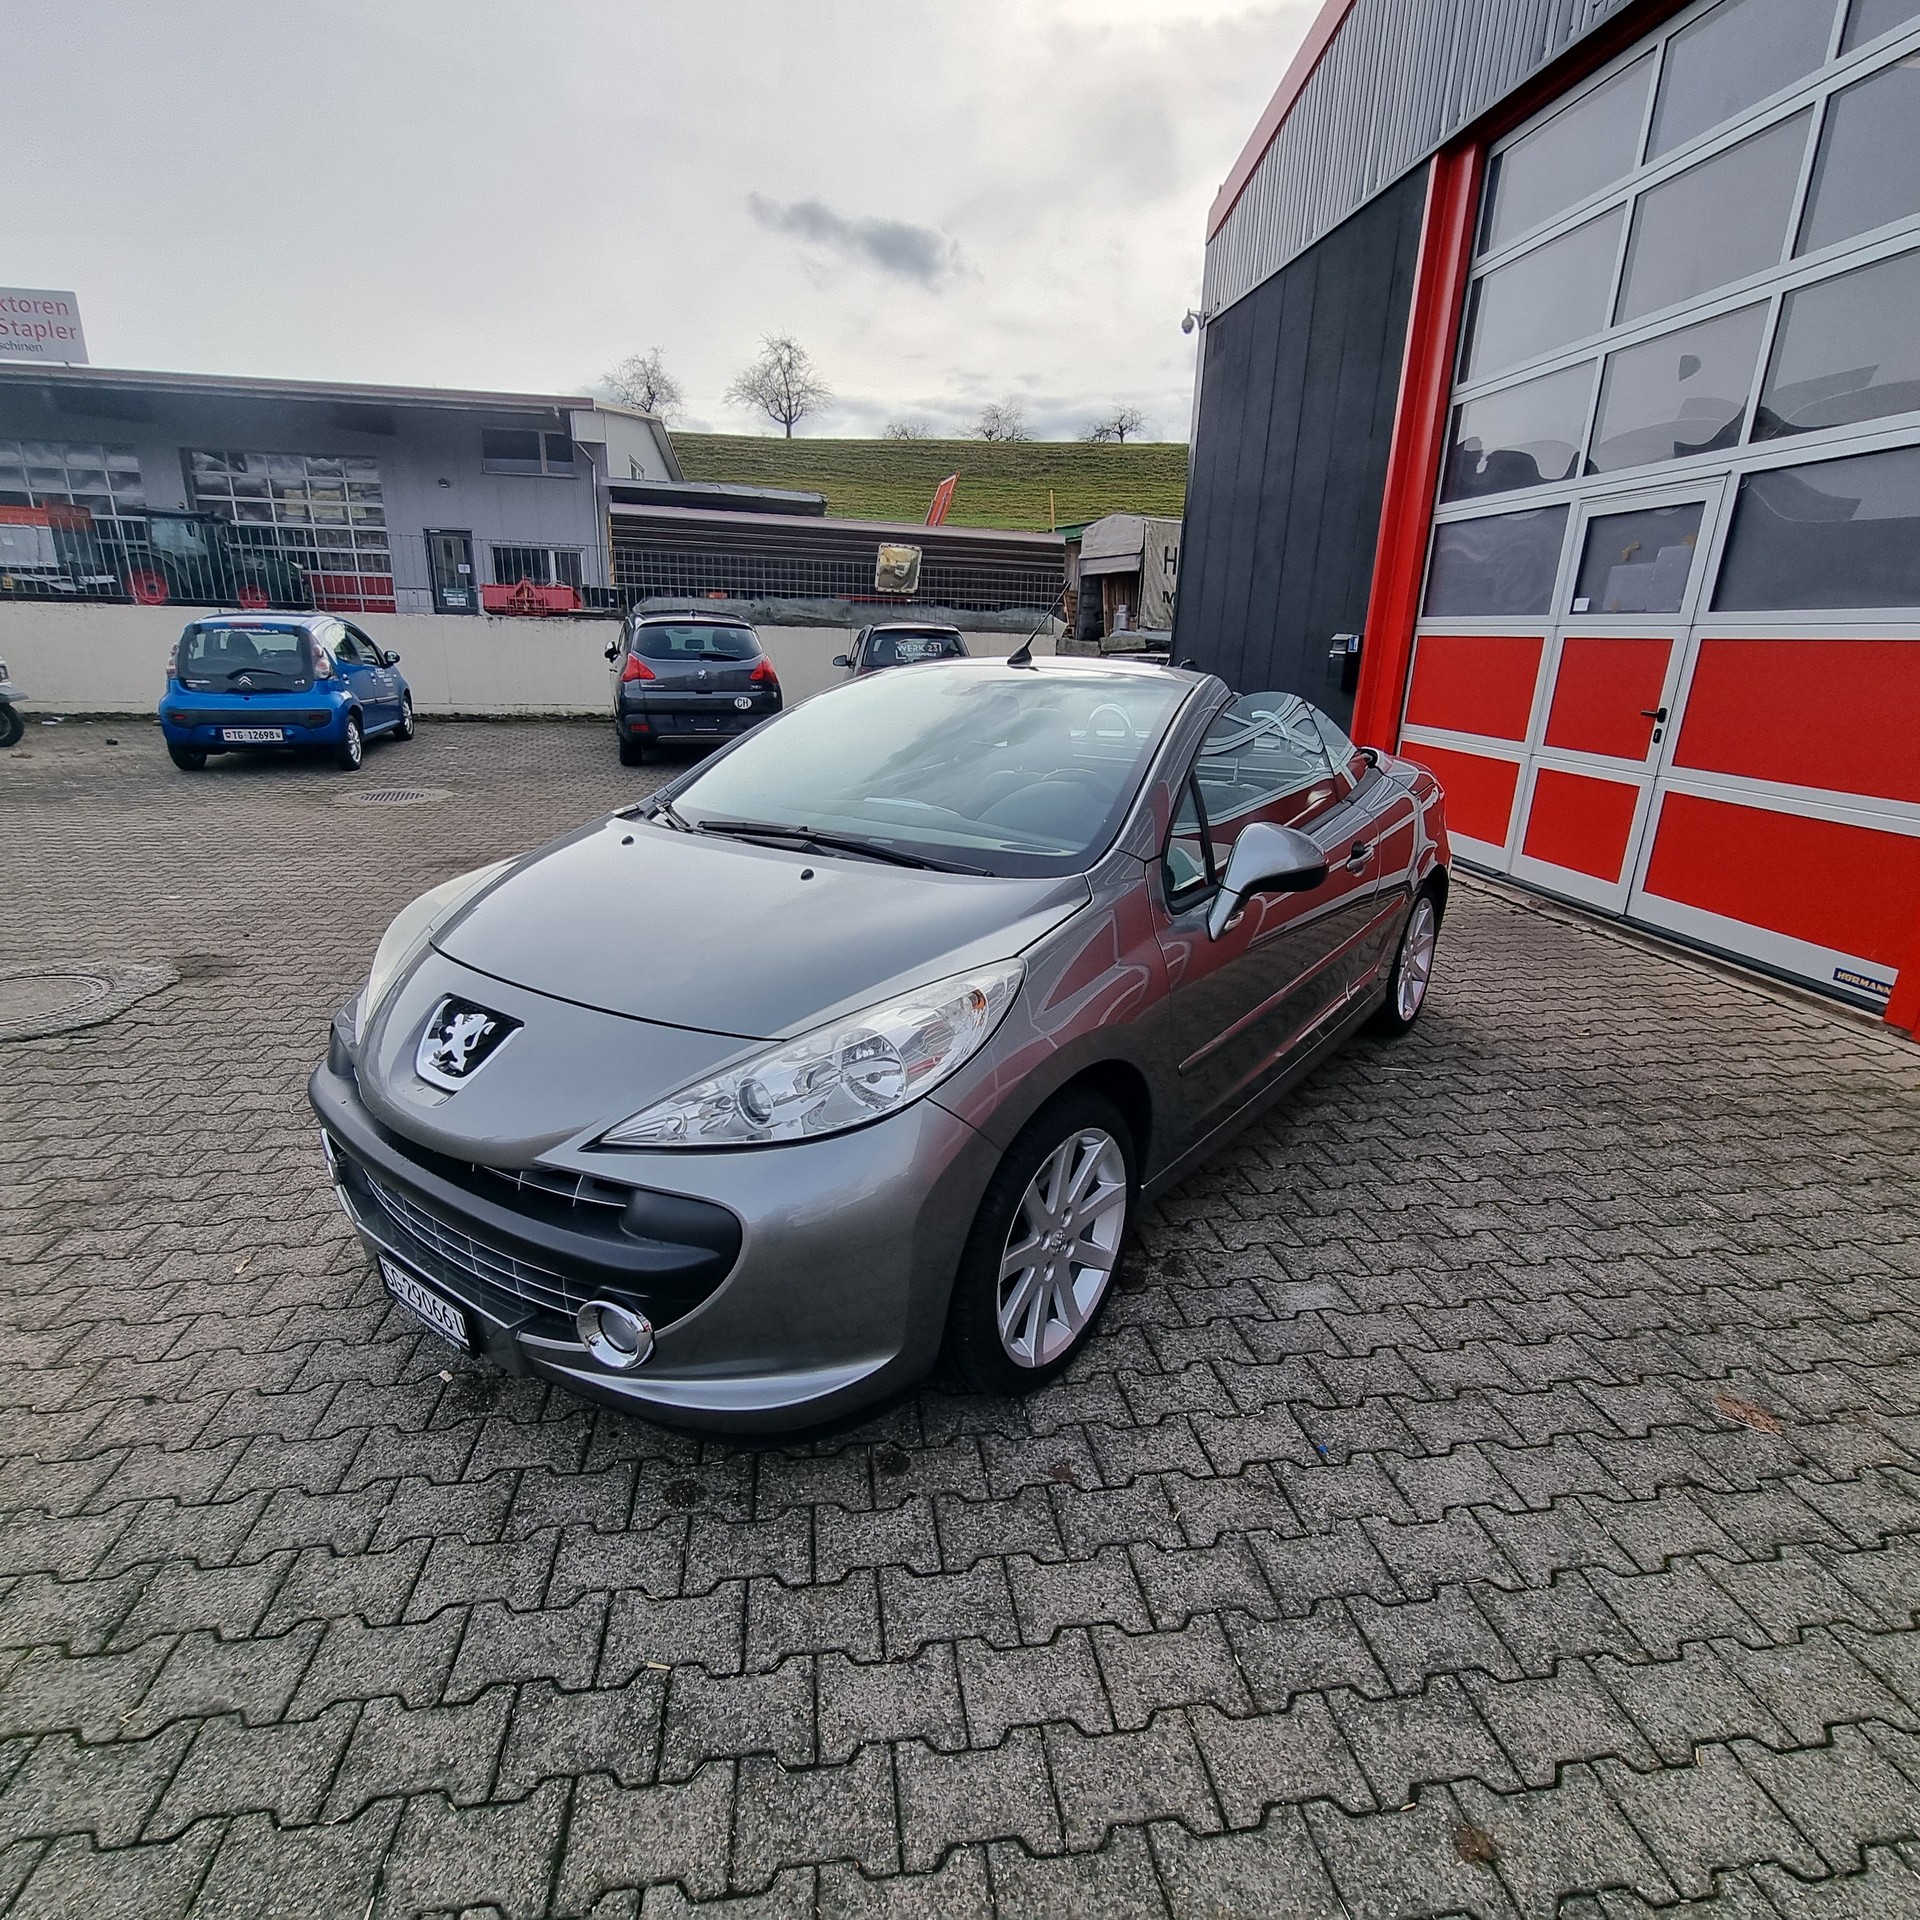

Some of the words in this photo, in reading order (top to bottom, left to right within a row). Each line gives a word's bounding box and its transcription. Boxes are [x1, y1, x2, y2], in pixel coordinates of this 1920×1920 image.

[0, 317, 76, 342] Stapler
[897, 644, 925, 652] WERK
[737, 699, 749, 708] CH
